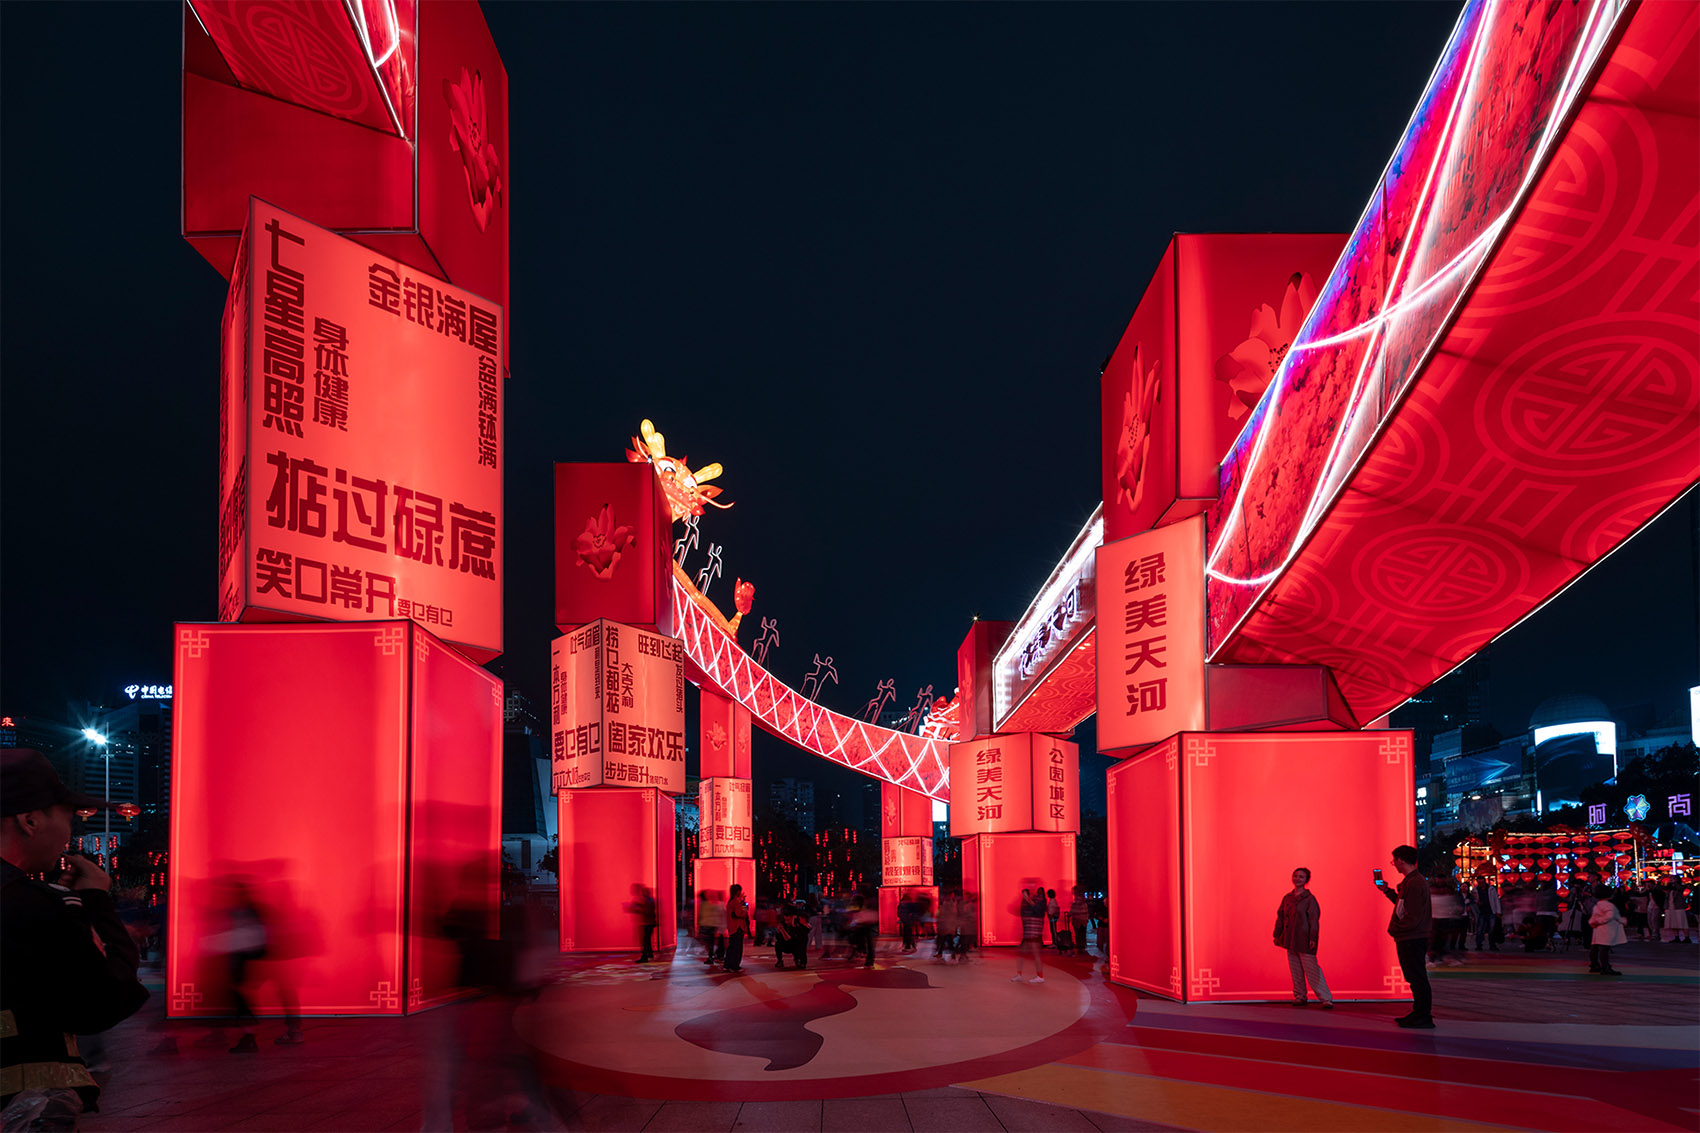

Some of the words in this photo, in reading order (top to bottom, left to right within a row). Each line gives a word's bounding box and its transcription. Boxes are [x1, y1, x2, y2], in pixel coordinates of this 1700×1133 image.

[263, 218, 305, 438] 七星高照
[368, 262, 497, 357] 金银满屋
[312, 316, 349, 432] 身体健康
[478, 354, 497, 470] 盆满钵满
[266, 450, 496, 580] 掂过碌蔗
[256, 547, 397, 618] 笑口常开
[397, 598, 453, 628] 要乜有乜
[605, 625, 620, 714] 捞乜都掂
[638, 633, 683, 664] 旺到飞起
[1125, 552, 1167, 717] 绿美天河
[621, 662, 634, 709] 大吉大利
[554, 722, 600, 763] 要乜有乜
[605, 761, 650, 784] 步步高升
[608, 720, 683, 762] 阖家欢乐
[977, 747, 1002, 821] 绿美天河
[1049, 747, 1064, 820] 公园城区
[1668, 793, 1691, 818] 尚
